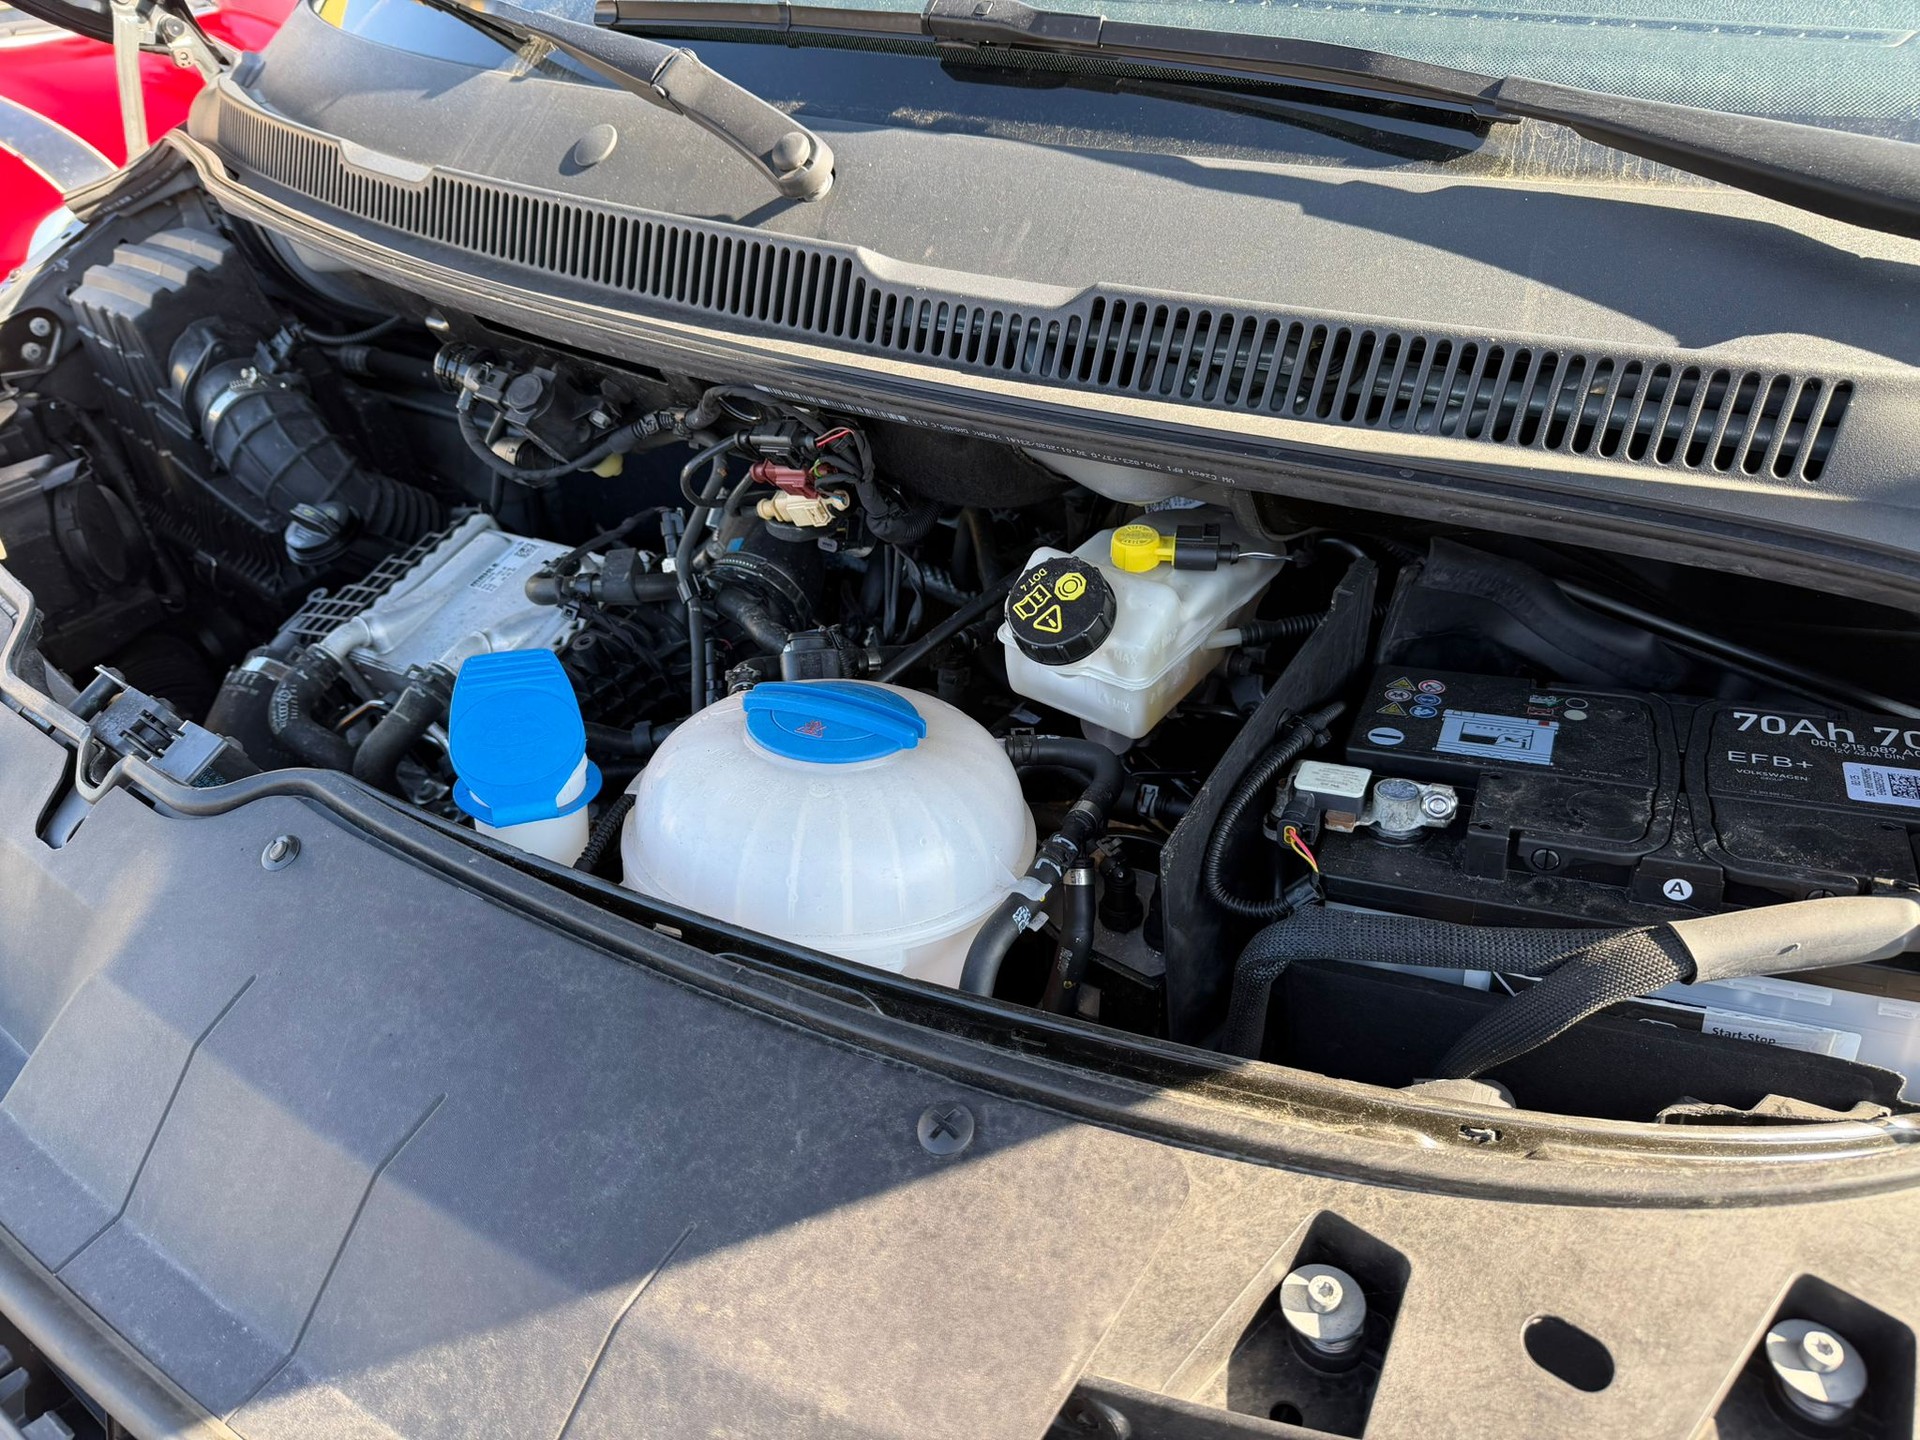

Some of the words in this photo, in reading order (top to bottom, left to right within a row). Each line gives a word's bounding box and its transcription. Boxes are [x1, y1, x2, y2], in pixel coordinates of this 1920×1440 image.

[1187, 469, 1217, 481] Czech
[1028, 568, 1047, 586] DOT
[1020, 584, 1028, 592] 4
[1733, 711, 1855, 744] 70Ah
[1811, 738, 1837, 748] 000
[1841, 743, 1866, 752] 915
[1870, 745, 1898, 755] 089
[1727, 750, 1814, 769] EFB+
[1854, 750, 1881, 759] 420A
[1884, 753, 1906, 762] DIN
[1735, 768, 1808, 782] VOLKSWAGEN
[1668, 882, 1685, 896] A
[1711, 1027, 1776, 1045] Start-Stop
